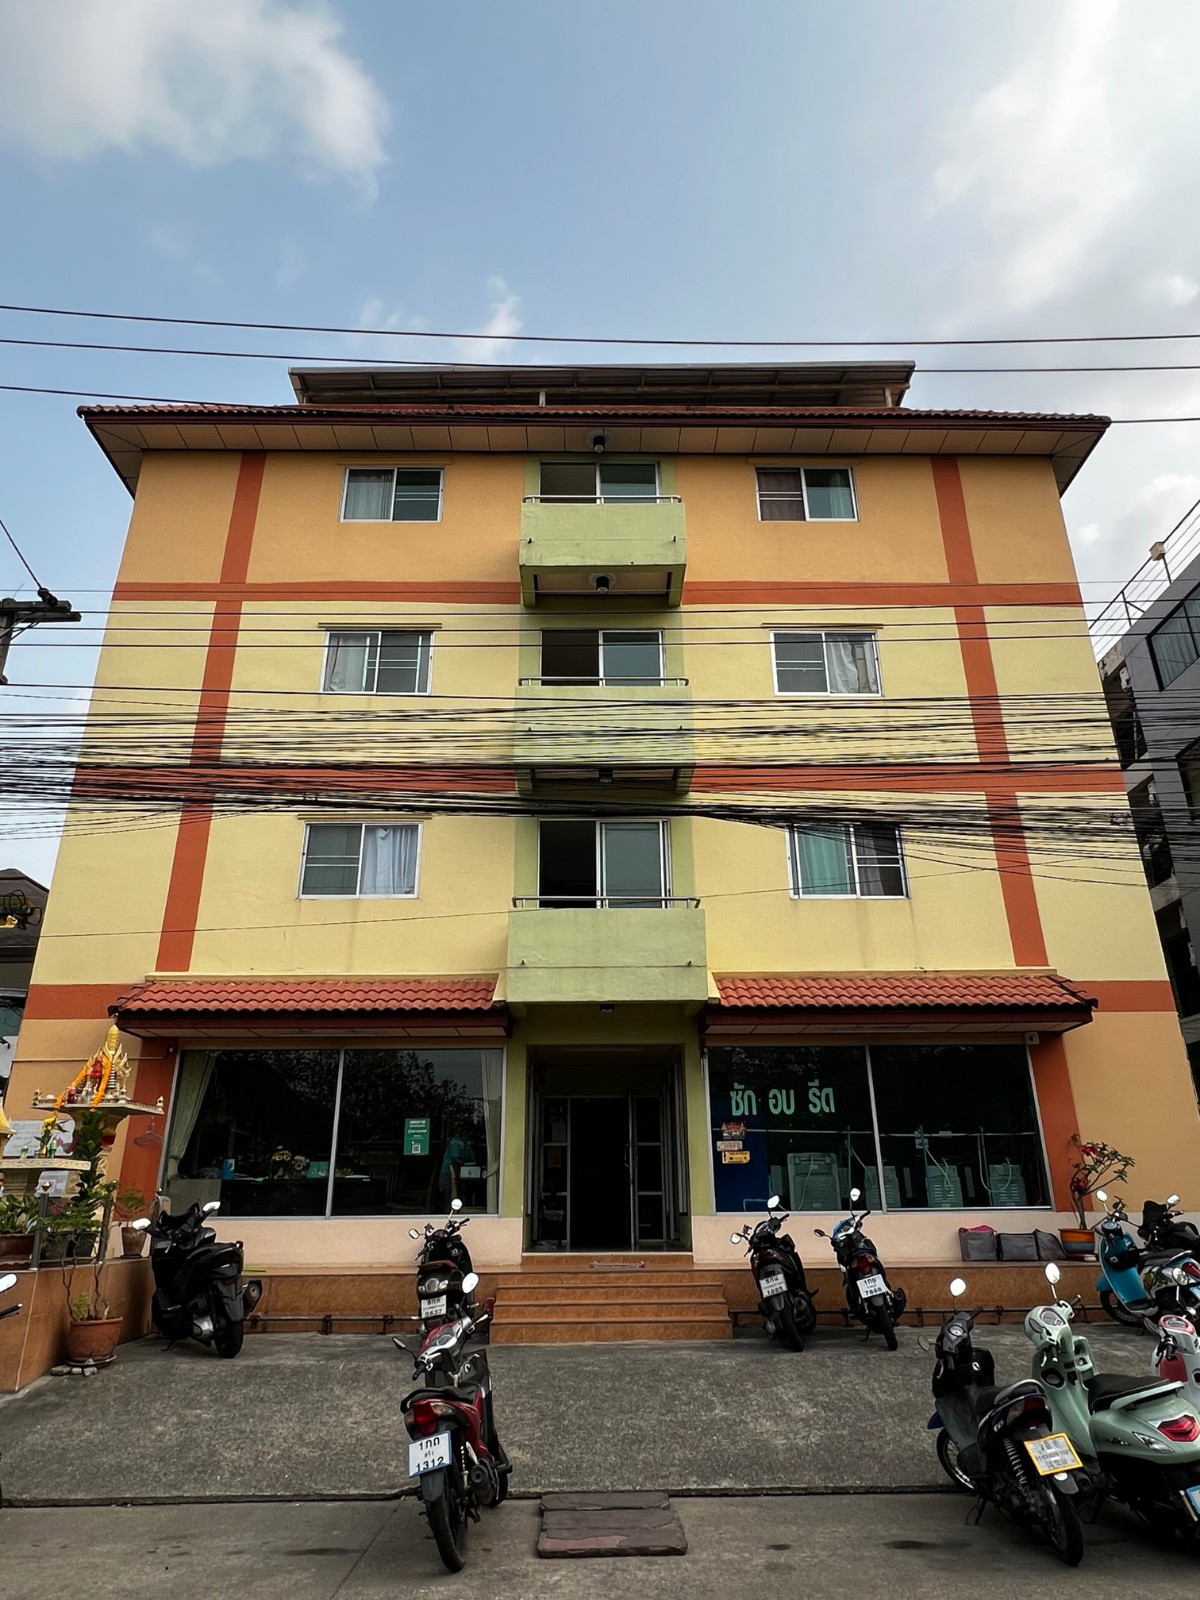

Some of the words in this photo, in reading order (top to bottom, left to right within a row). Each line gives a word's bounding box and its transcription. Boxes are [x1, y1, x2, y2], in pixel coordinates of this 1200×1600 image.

[730, 1082, 757, 1116] ซัก
[768, 1088, 796, 1115] อบ
[807, 1079, 836, 1113] รีด
[416, 1456, 444, 1473] 1312
